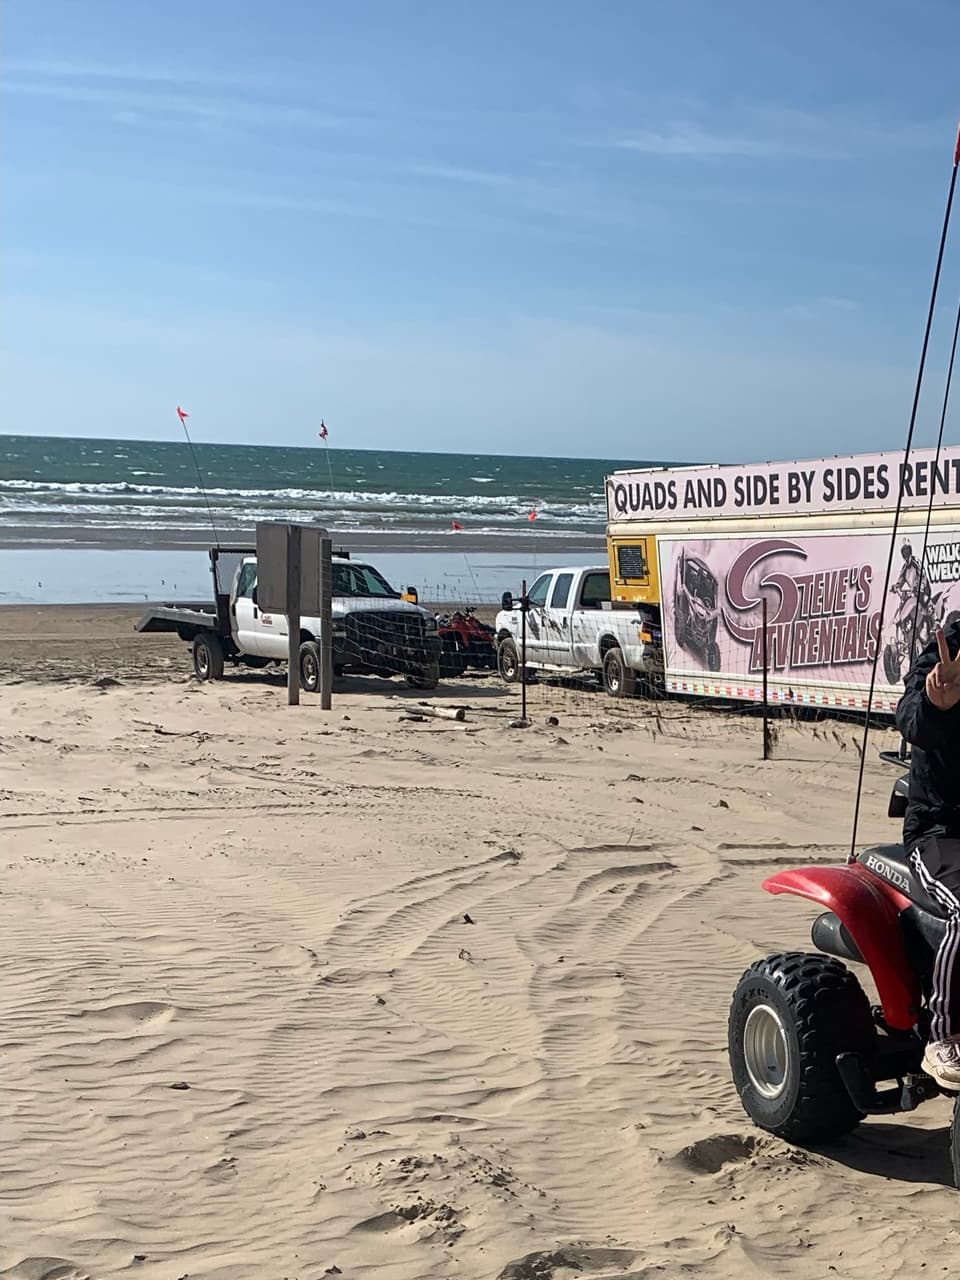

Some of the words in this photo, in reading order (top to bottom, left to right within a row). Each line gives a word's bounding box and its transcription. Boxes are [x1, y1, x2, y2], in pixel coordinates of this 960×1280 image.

[614, 480, 678, 514] QUADS
[683, 478, 727, 509] AND
[734, 473, 780, 507] SIDE
[788, 470, 816, 504] BY
[823, 464, 889, 501] SIDES
[721, 538, 872, 643] STEVE'S
[750, 622, 792, 671] ATV
[791, 611, 882, 667] RENTALS
[866, 855, 911, 893] HONDA
